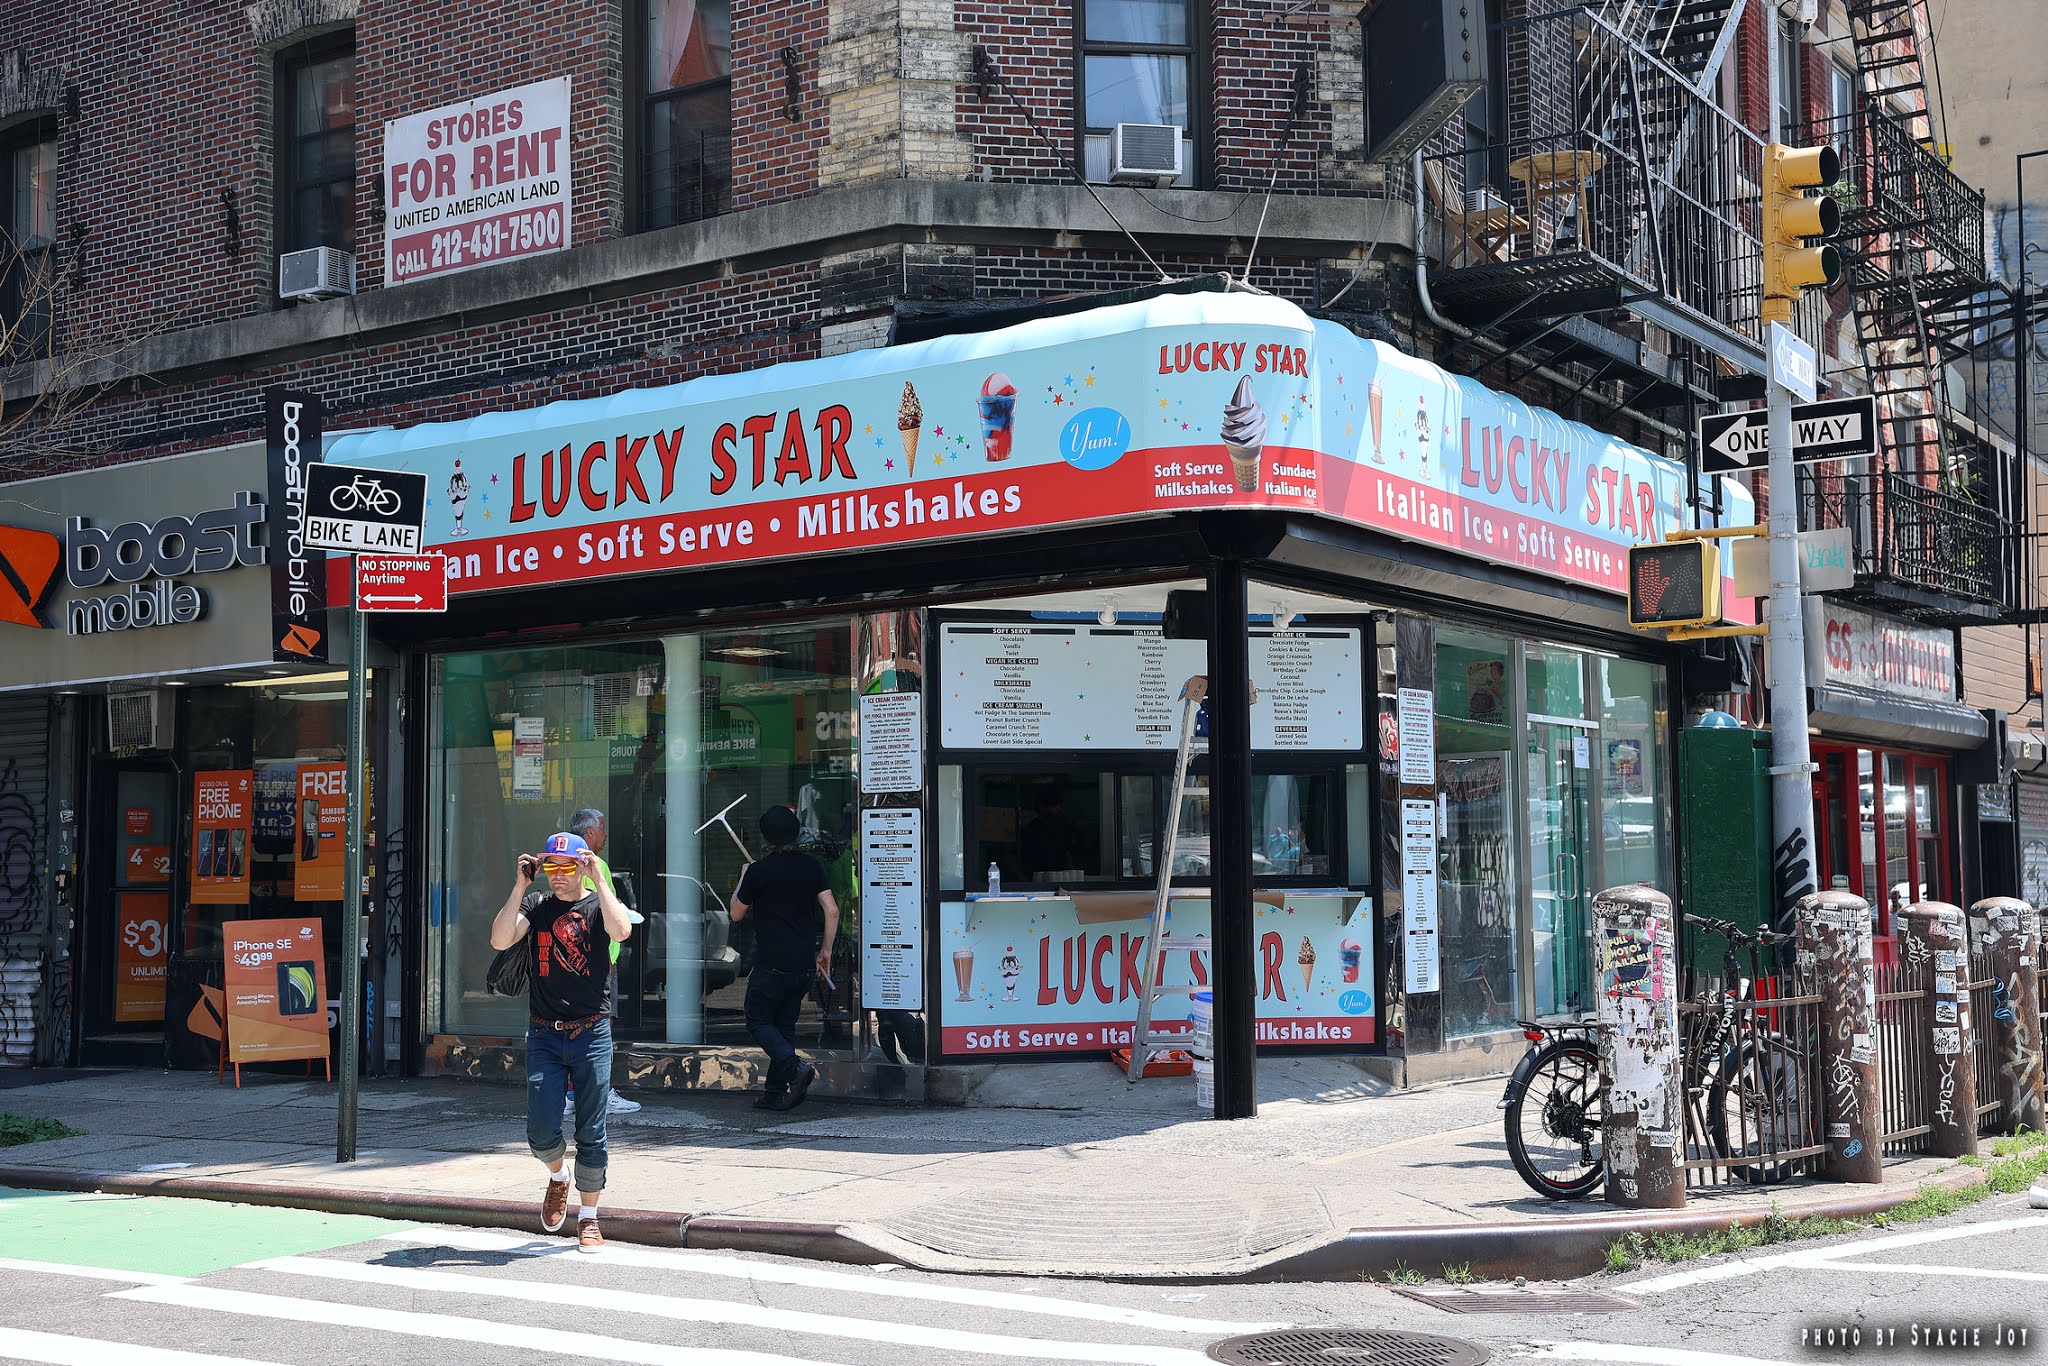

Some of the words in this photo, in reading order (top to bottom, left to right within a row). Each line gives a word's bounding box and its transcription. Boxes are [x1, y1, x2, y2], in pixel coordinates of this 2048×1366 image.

[427, 99, 523, 150] STORES
[391, 153, 457, 208] FOR
[473, 127, 562, 190] RENT
[394, 206, 440, 230] UNITED
[446, 188, 515, 218] AMERICAN
[521, 180, 560, 201] LAND
[396, 248, 427, 276] CALL
[431, 208, 560, 268] 212-431-7500
[1160, 341, 1246, 376] LUCKY
[1255, 342, 1308, 378] STAR
[1780, 347, 1794, 373] ONE
[1798, 356, 1812, 383] WAY
[1069, 419, 1122, 456] Yum!
[1728, 428, 1769, 453] ONE
[1798, 416, 1851, 443] WAY
[510, 426, 685, 524] LUCKY
[710, 404, 858, 496] STAR
[1154, 462, 1184, 478] Soft
[1188, 462, 1224, 477] Serve
[1272, 462, 1317, 479] Sundaes
[1155, 480, 1234, 498] Milkshakes
[1265, 480, 1296, 498] Italian
[1298, 483, 1317, 499] Ice
[1461, 417, 1572, 513] LUCKY
[1586, 467, 1657, 544] STAR
[65, 491, 267, 588] boost
[310, 521, 354, 543] BIKE
[363, 526, 415, 549] LANE
[497, 541, 539, 573] Ice
[577, 526, 645, 565] Soft
[659, 516, 754, 555] Serve
[797, 483, 1022, 540] Milkshakes
[1376, 478, 1456, 534] Italian
[1463, 506, 1495, 546] Ice
[1517, 530, 1558, 563] Soft
[1564, 540, 1611, 576] Serve
[361, 560, 376, 571] NO
[380, 560, 431, 571] STOPPING
[362, 573, 406, 586] Anytime
[67, 580, 204, 635] mobile
[1826, 619, 1853, 672] GS
[198, 803, 242, 819] PHONE
[199, 788, 230, 803] FREE
[130, 848, 143, 866] 4
[233, 940, 274, 951] iPhone
[276, 939, 292, 949] SE
[1606, 943, 1642, 959] PHOTOS
[1609, 935, 1629, 947] FULL
[1344, 993, 1368, 1013] Yum!
[966, 1028, 1011, 1049] Soft
[1018, 1028, 1078, 1047] Serve
[1254, 1020, 1353, 1041] ilkshakes
